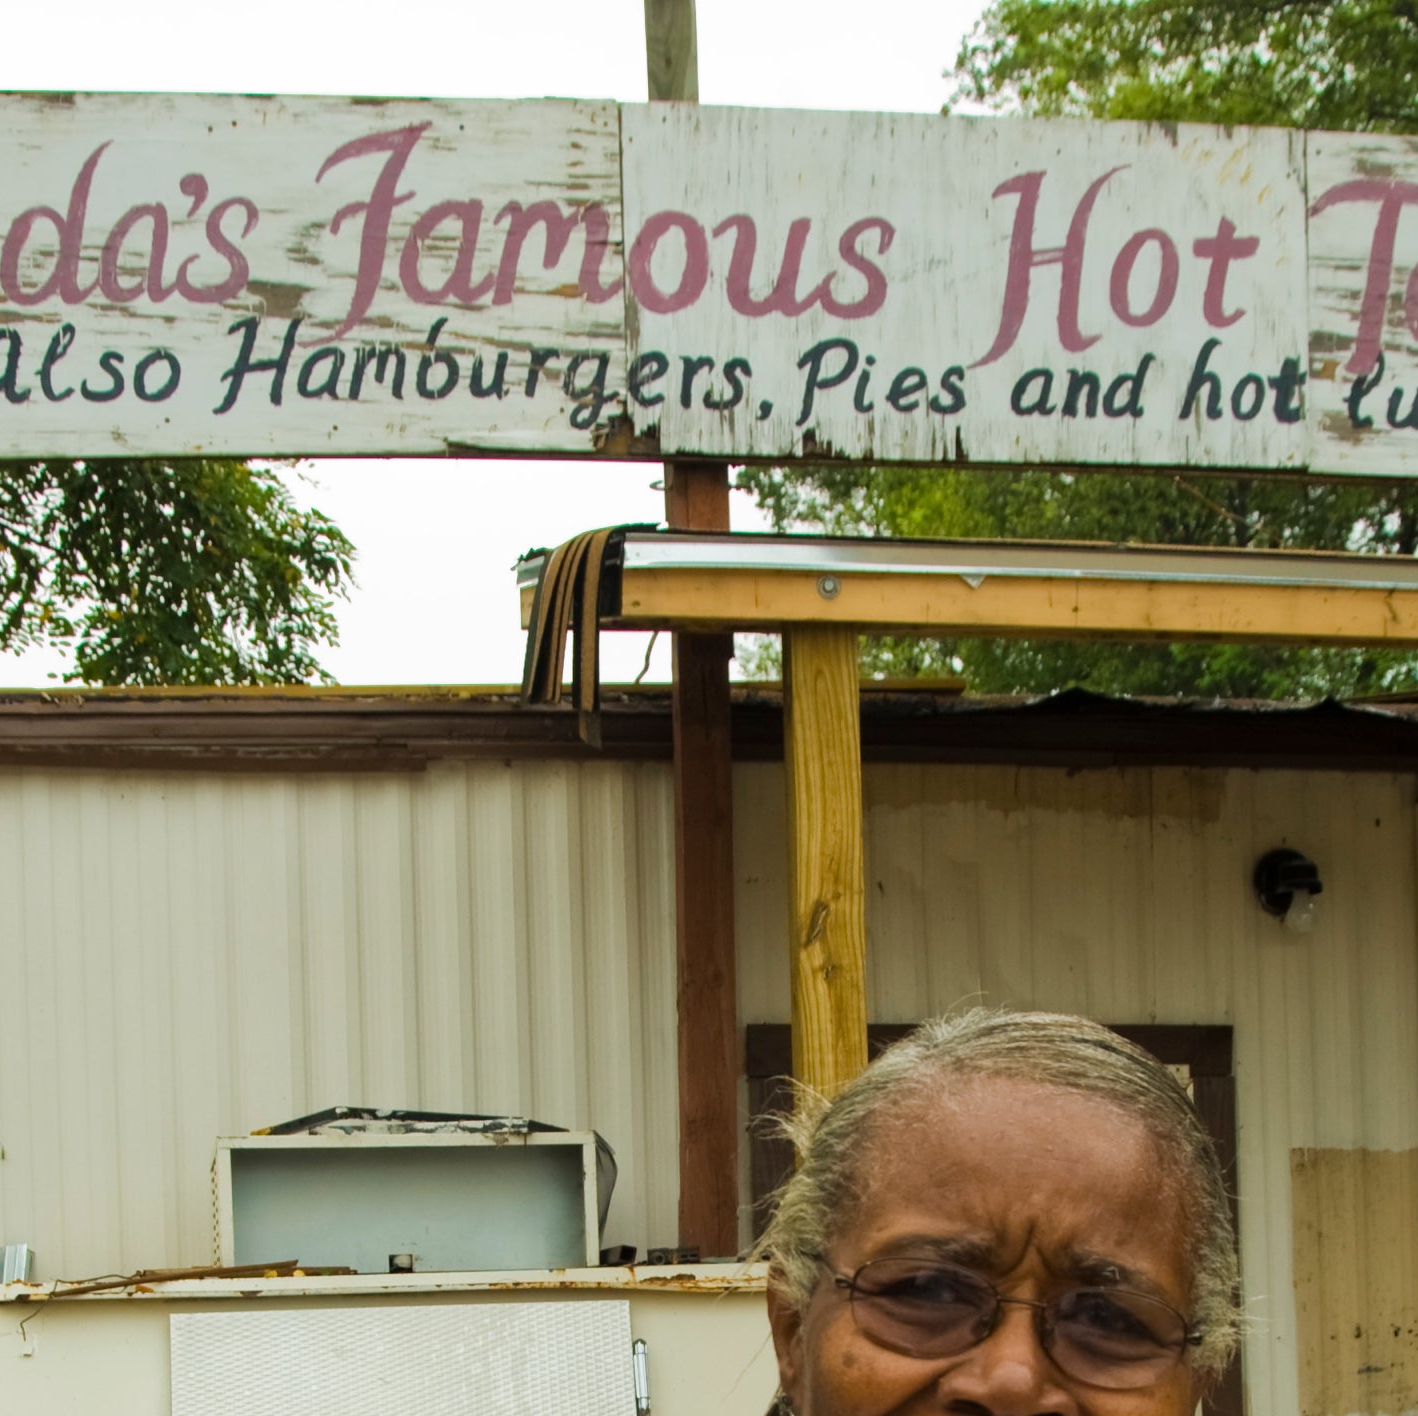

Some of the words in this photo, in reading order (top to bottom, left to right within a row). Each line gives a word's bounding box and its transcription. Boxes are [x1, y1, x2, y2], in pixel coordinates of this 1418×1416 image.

[298, 120, 896, 345] Famous
[967, 164, 1261, 369] Hot
[211, 316, 774, 430] Hamburgers,
[795, 337, 967, 427] Pies
[1009, 352, 1157, 419] and
[1179, 337, 1308, 424] hot
